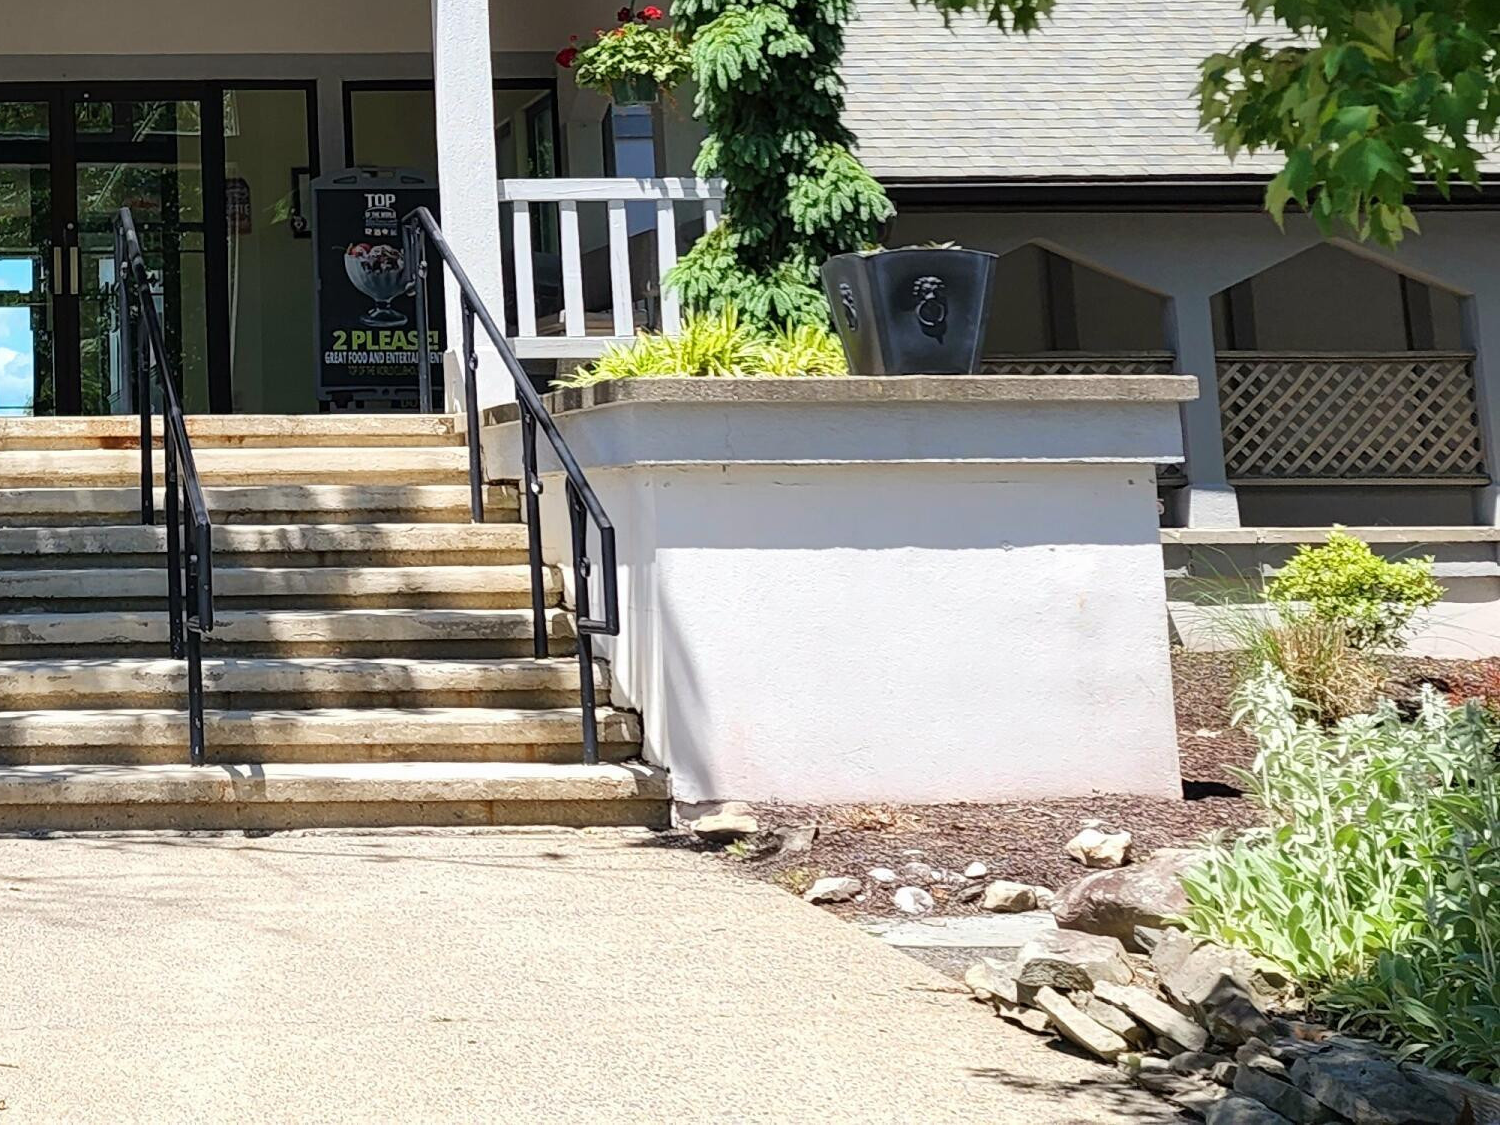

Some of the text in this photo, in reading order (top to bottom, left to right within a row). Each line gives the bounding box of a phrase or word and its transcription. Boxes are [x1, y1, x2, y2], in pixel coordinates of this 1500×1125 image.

[364, 194, 396, 208] TOP
[332, 330, 348, 350] 2
[324, 351, 443, 364] GREAT FOOD AND ENTERTAIENT
